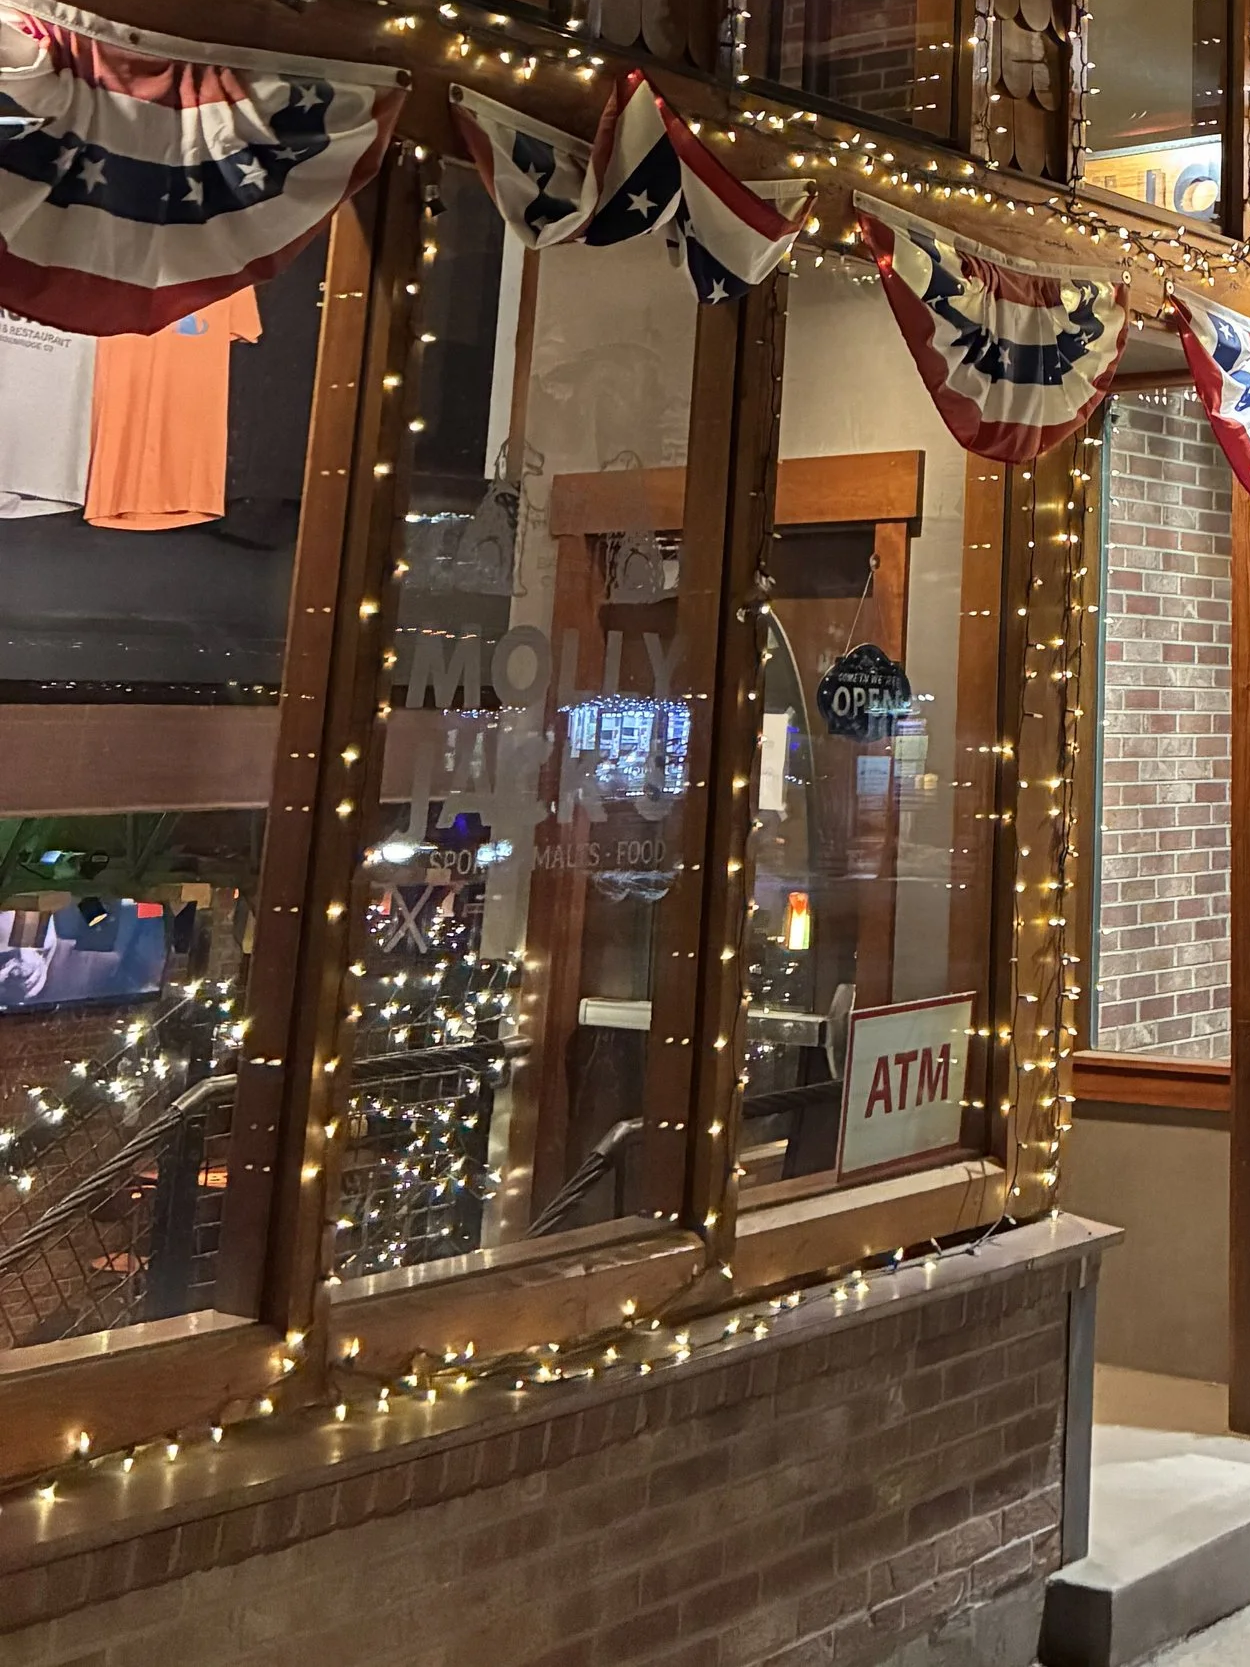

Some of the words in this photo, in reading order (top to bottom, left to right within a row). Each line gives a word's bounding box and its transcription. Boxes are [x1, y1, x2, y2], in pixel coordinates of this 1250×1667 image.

[405, 623, 688, 709] MOLLY
[832, 686, 905, 718] OPEN
[534, 842, 600, 870] MALTS
[616, 838, 667, 865] FOOD
[864, 1043, 952, 1119] ATM
